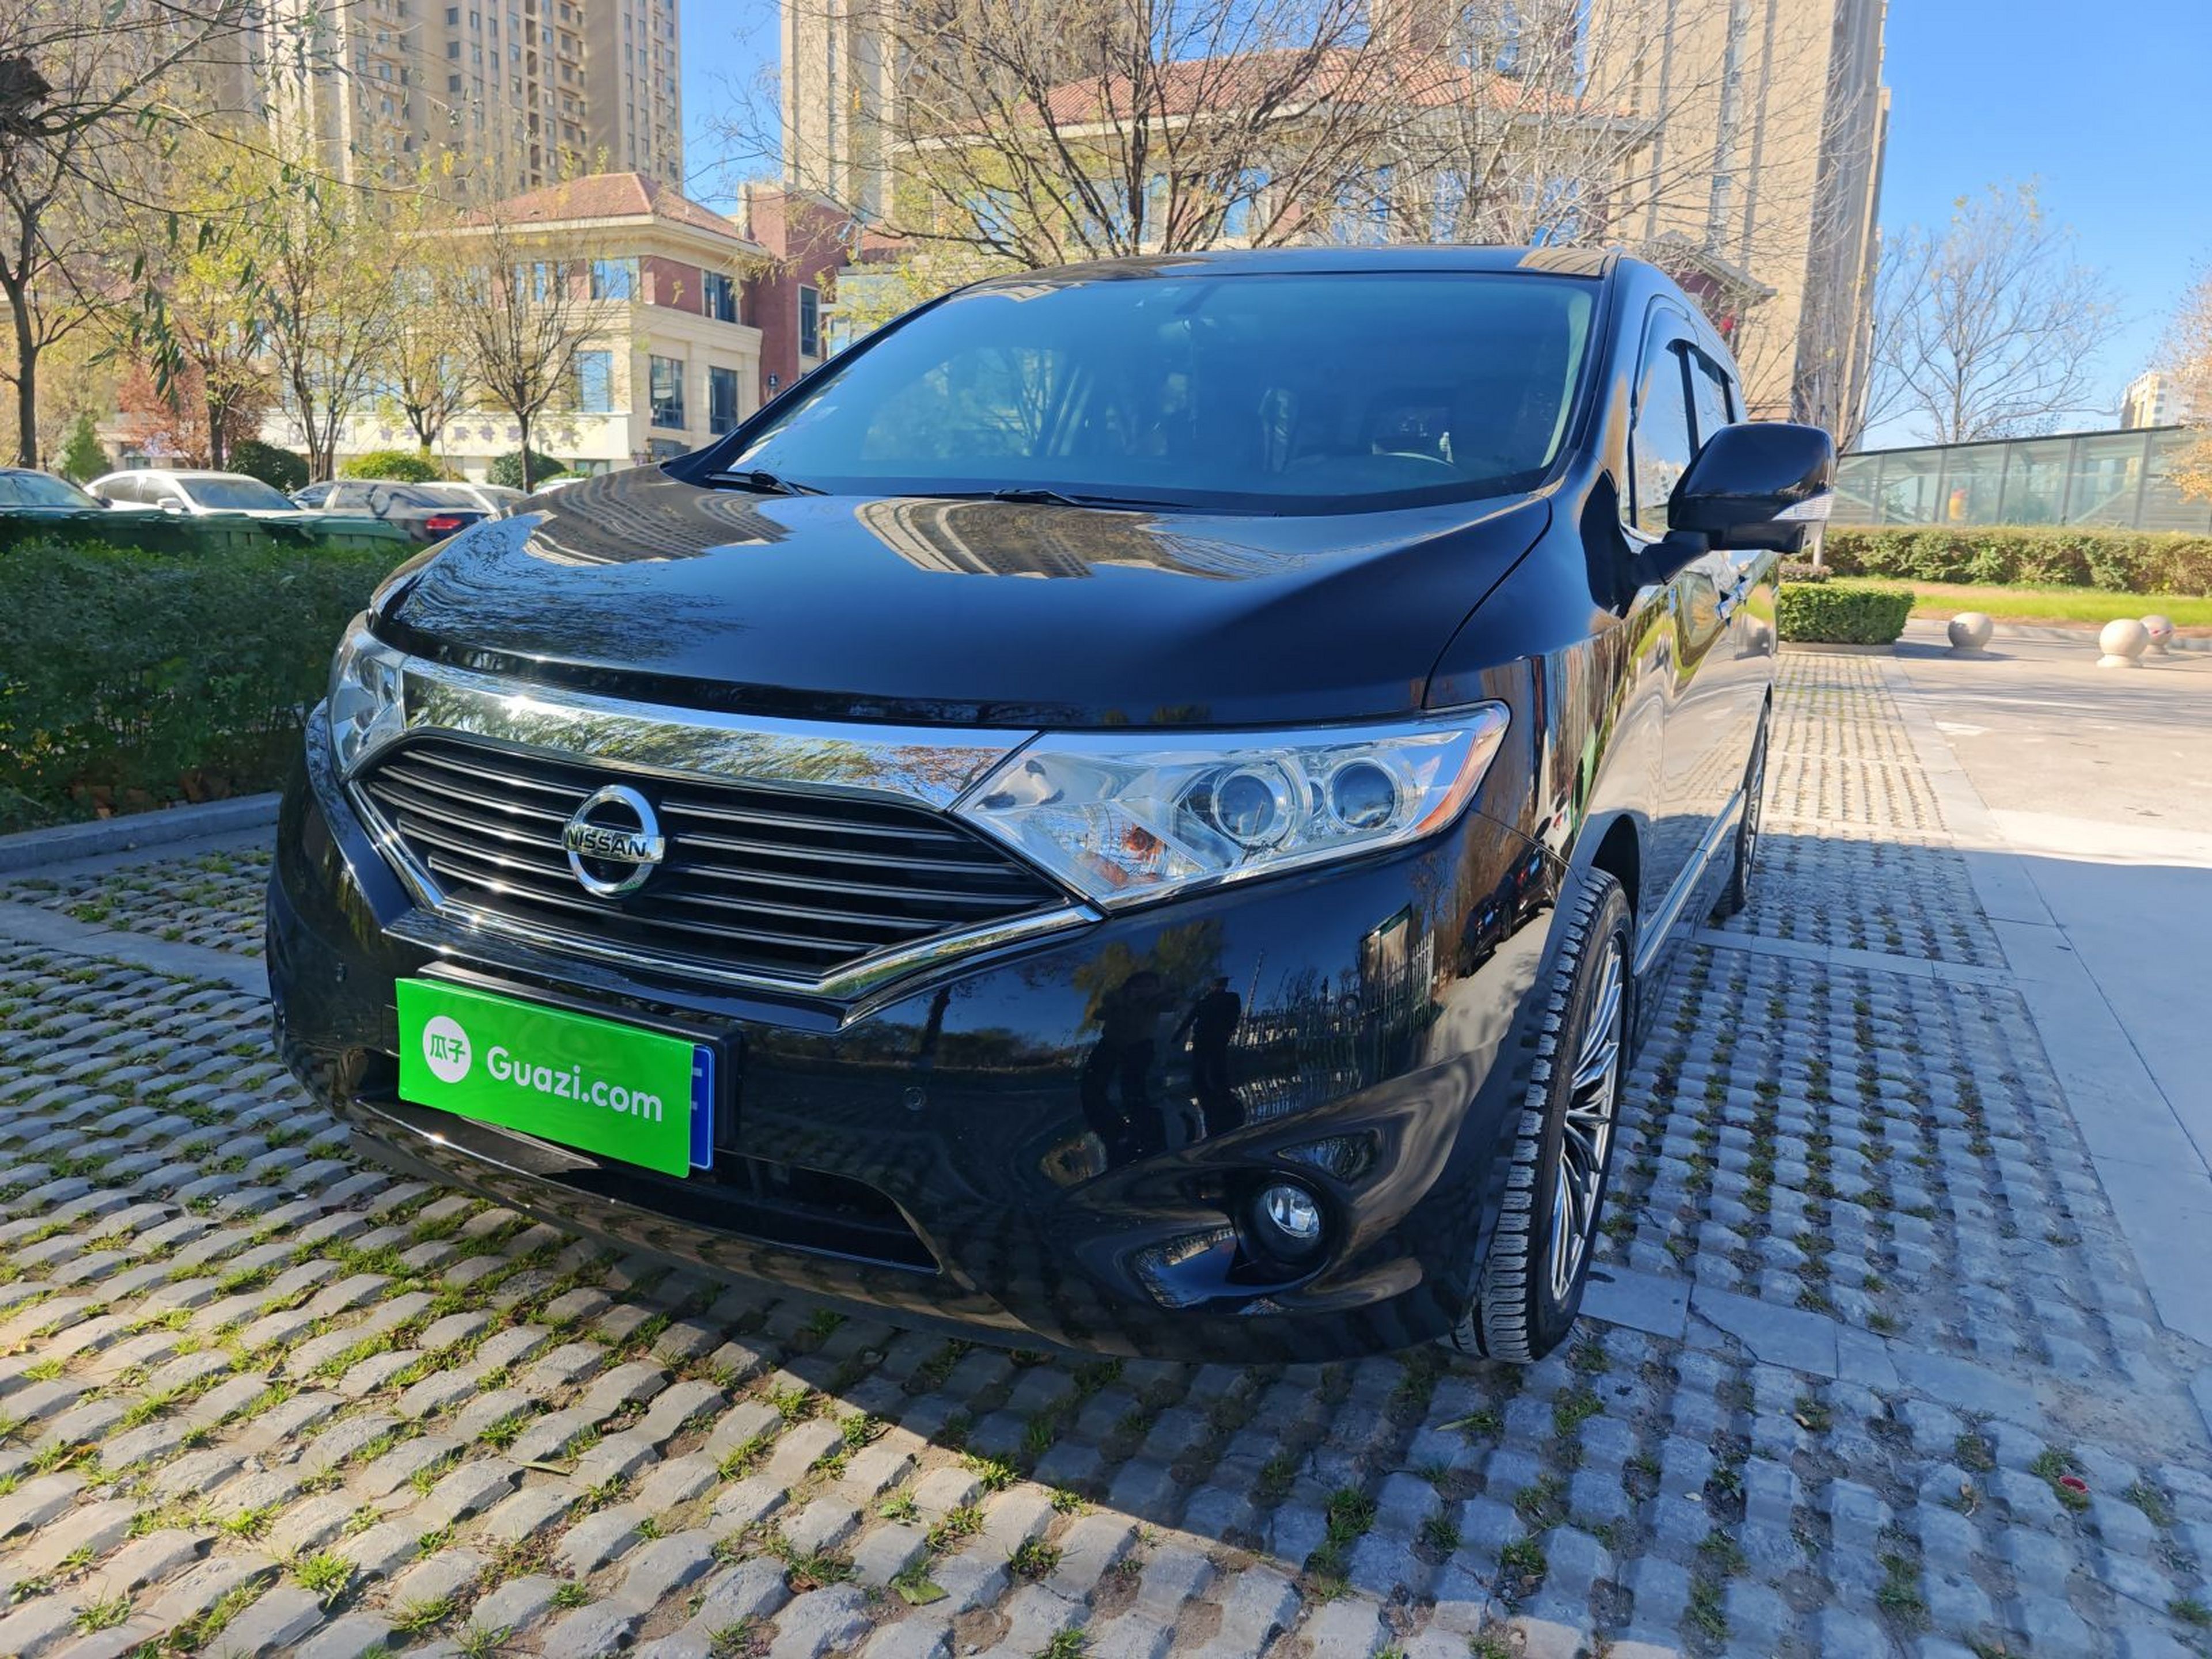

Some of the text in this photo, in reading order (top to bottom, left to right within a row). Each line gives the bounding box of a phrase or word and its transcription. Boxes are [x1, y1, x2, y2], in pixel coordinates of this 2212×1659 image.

[566, 828, 646, 857] NISSAN
[430, 1034, 466, 1063] 瓜子
[487, 1046, 662, 1122] Guazi.com
